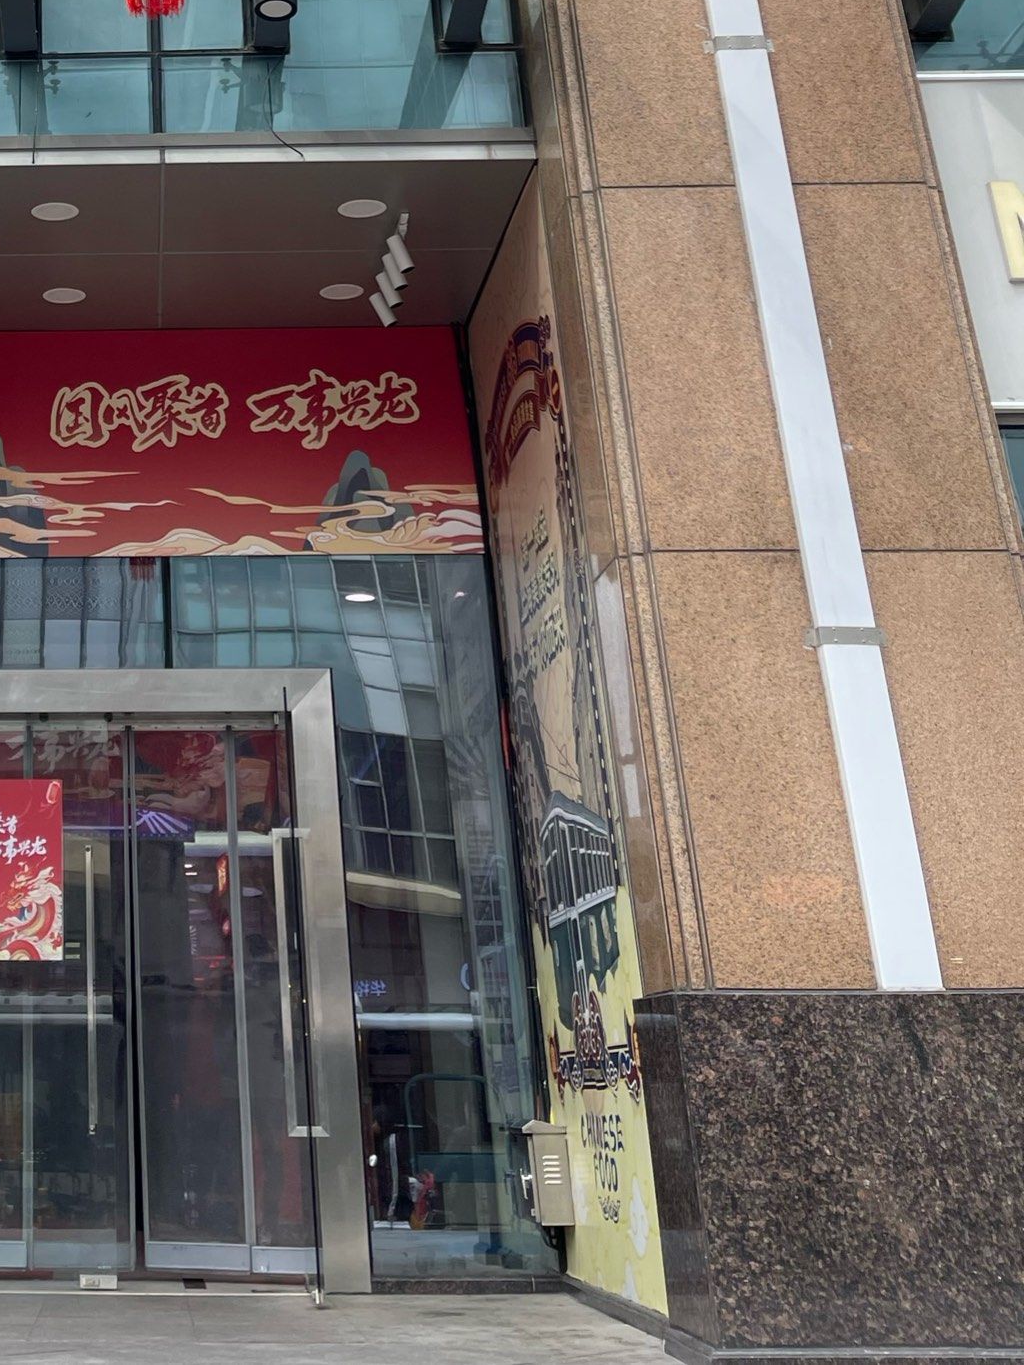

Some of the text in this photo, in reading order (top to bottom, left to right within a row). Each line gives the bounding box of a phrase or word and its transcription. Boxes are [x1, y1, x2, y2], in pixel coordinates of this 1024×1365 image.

[246, 368, 420, 450] 万事兴龙
[581, 1113, 625, 1152] CHINESE
[593, 1151, 619, 1192] FOOD
